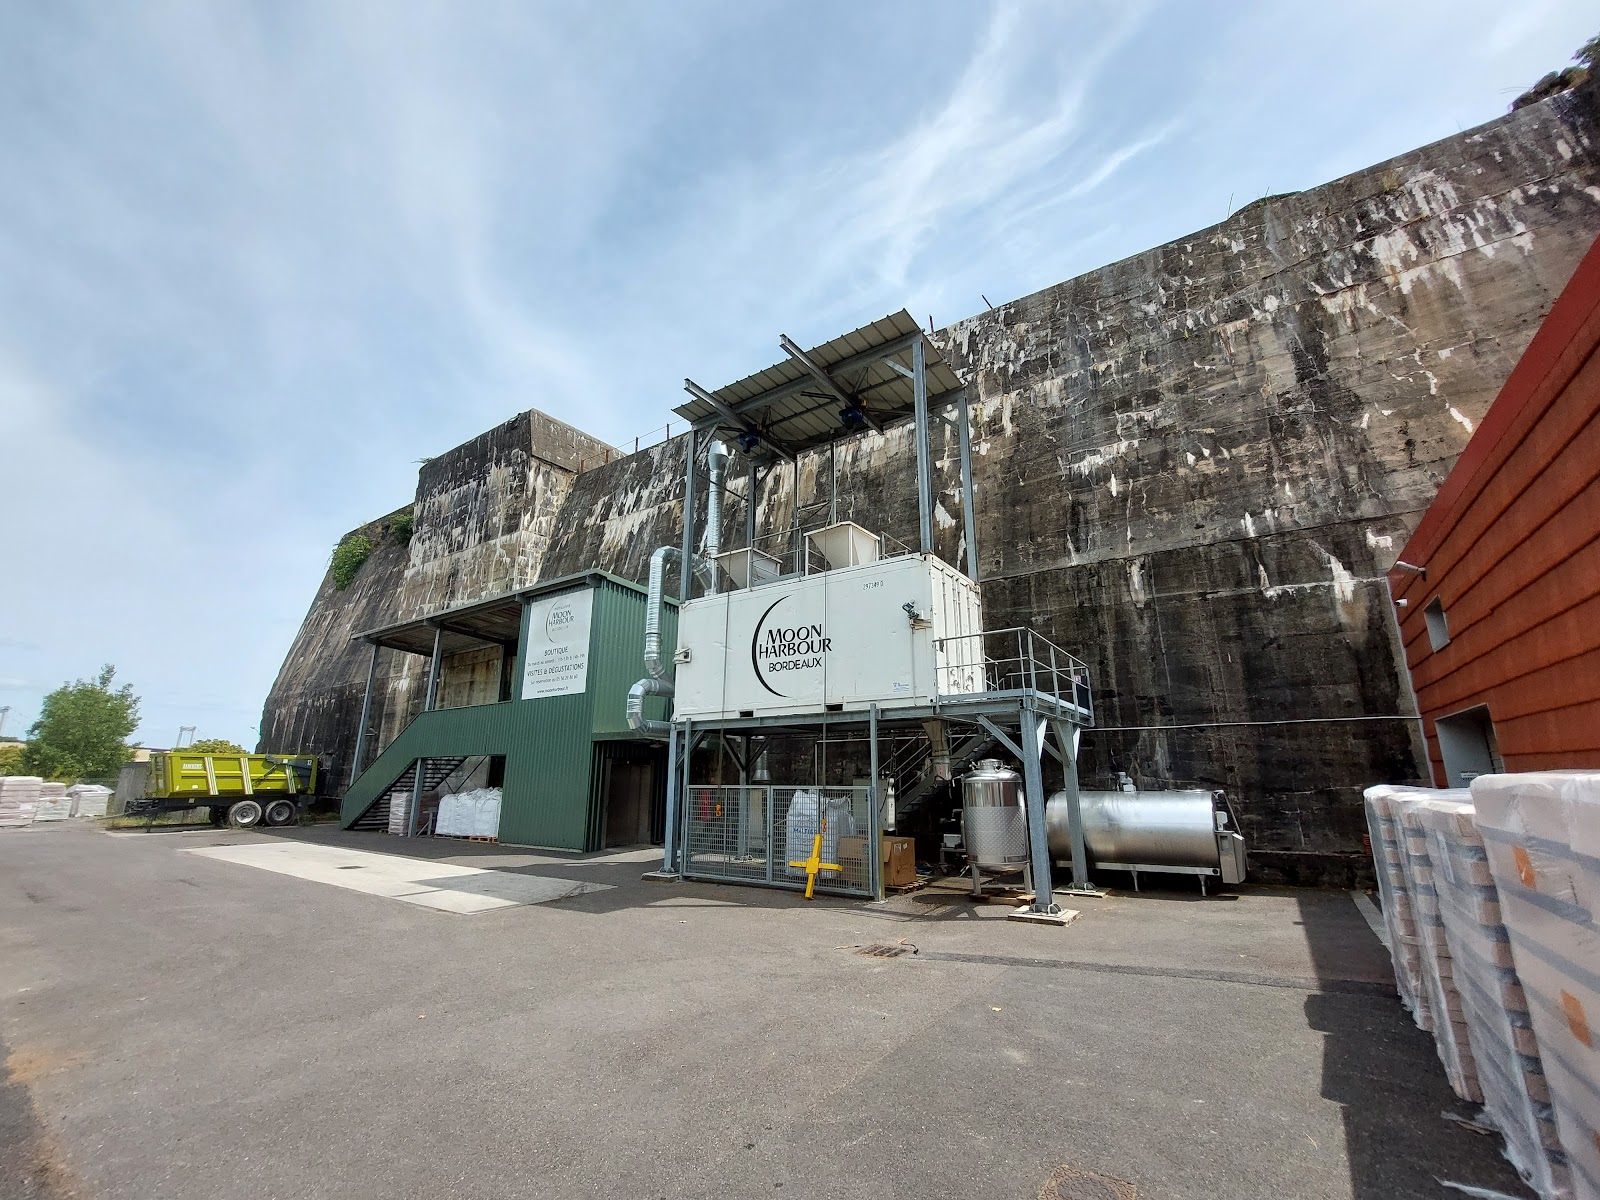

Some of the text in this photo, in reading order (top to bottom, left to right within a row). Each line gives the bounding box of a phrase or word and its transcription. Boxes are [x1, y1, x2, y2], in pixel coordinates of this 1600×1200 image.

[549, 615, 574, 626] HARBOUR
[552, 610, 571, 620] MOON
[766, 624, 822, 645] MOON
[544, 646, 568, 656] BOUTIQUE
[759, 638, 832, 659] HARBOUR
[527, 668, 543, 677] VISITES
[548, 663, 584, 674] DÉGUSTATIONS
[768, 657, 822, 672] BORDEAUX
